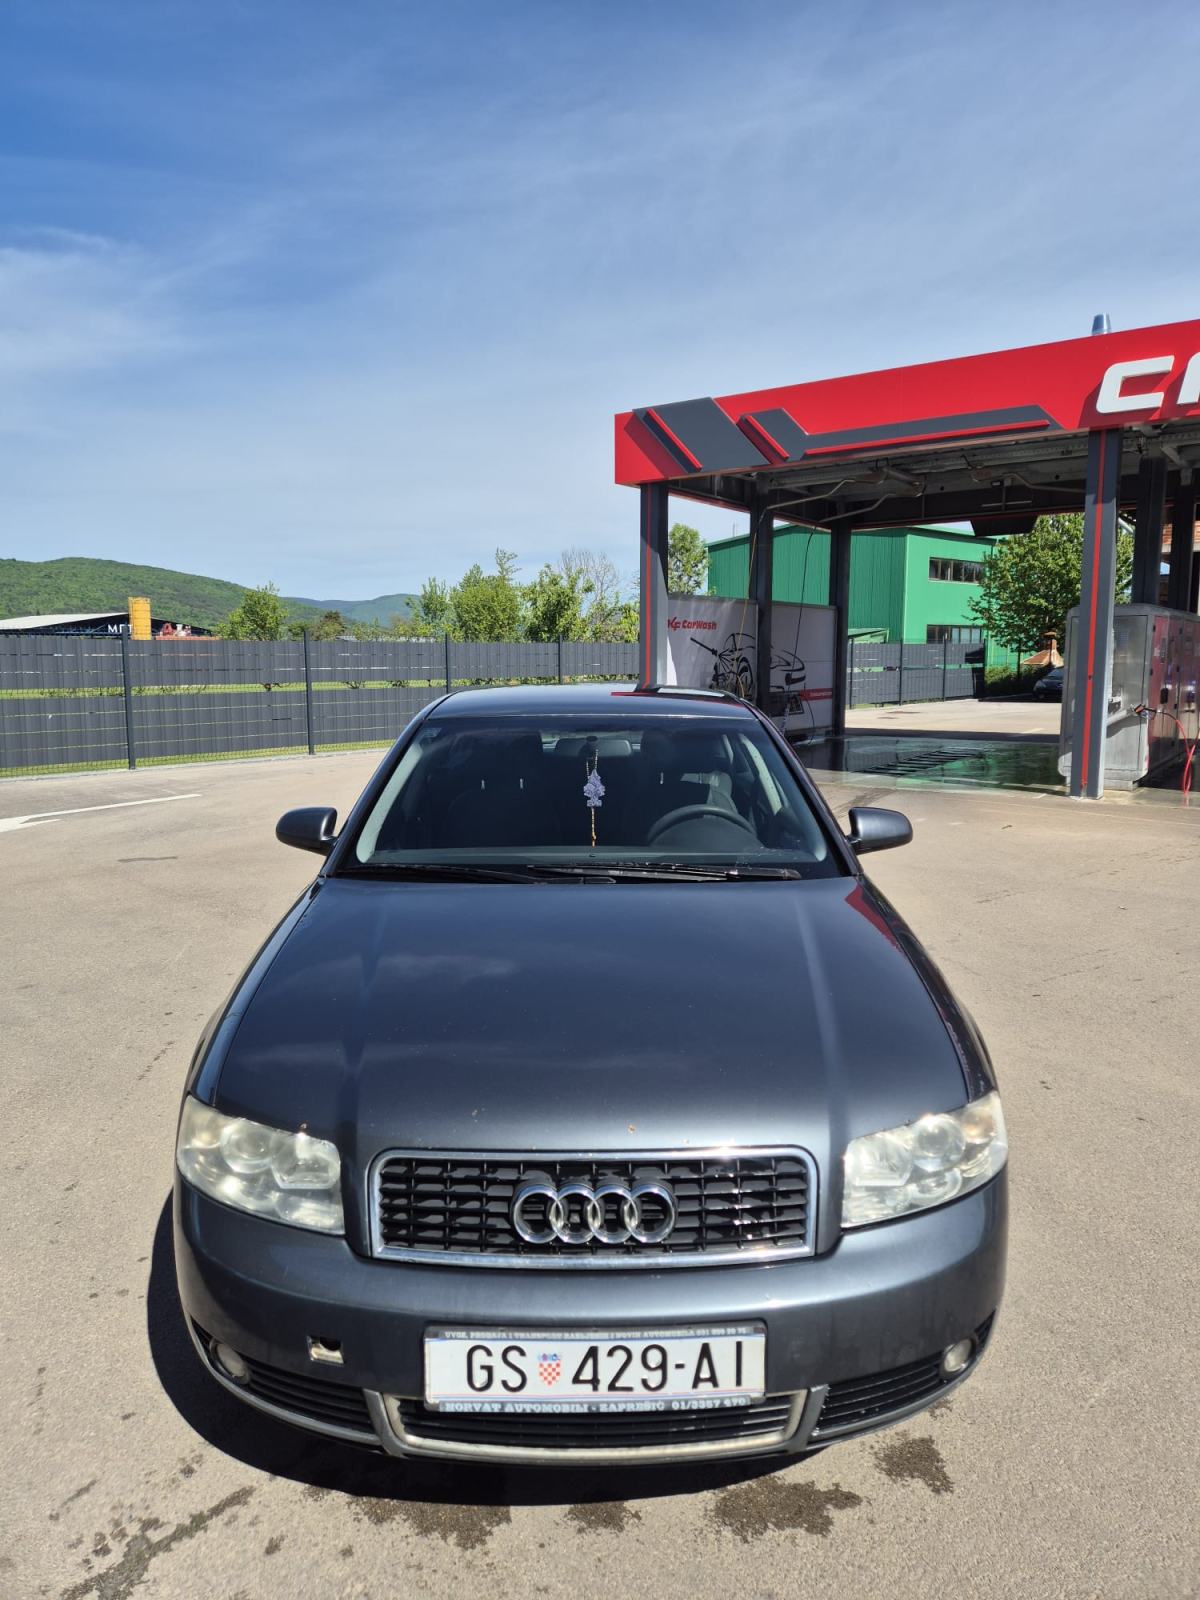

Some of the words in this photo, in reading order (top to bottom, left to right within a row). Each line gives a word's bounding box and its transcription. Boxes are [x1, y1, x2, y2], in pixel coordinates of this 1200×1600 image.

[682, 619, 717, 630] CarWash
[465, 1344, 528, 1392] GS
[571, 1340, 743, 1392] 429-AI
[445, 1402, 501, 1412] HORVAT
[504, 1403, 588, 1413] AUTOMOBILI
